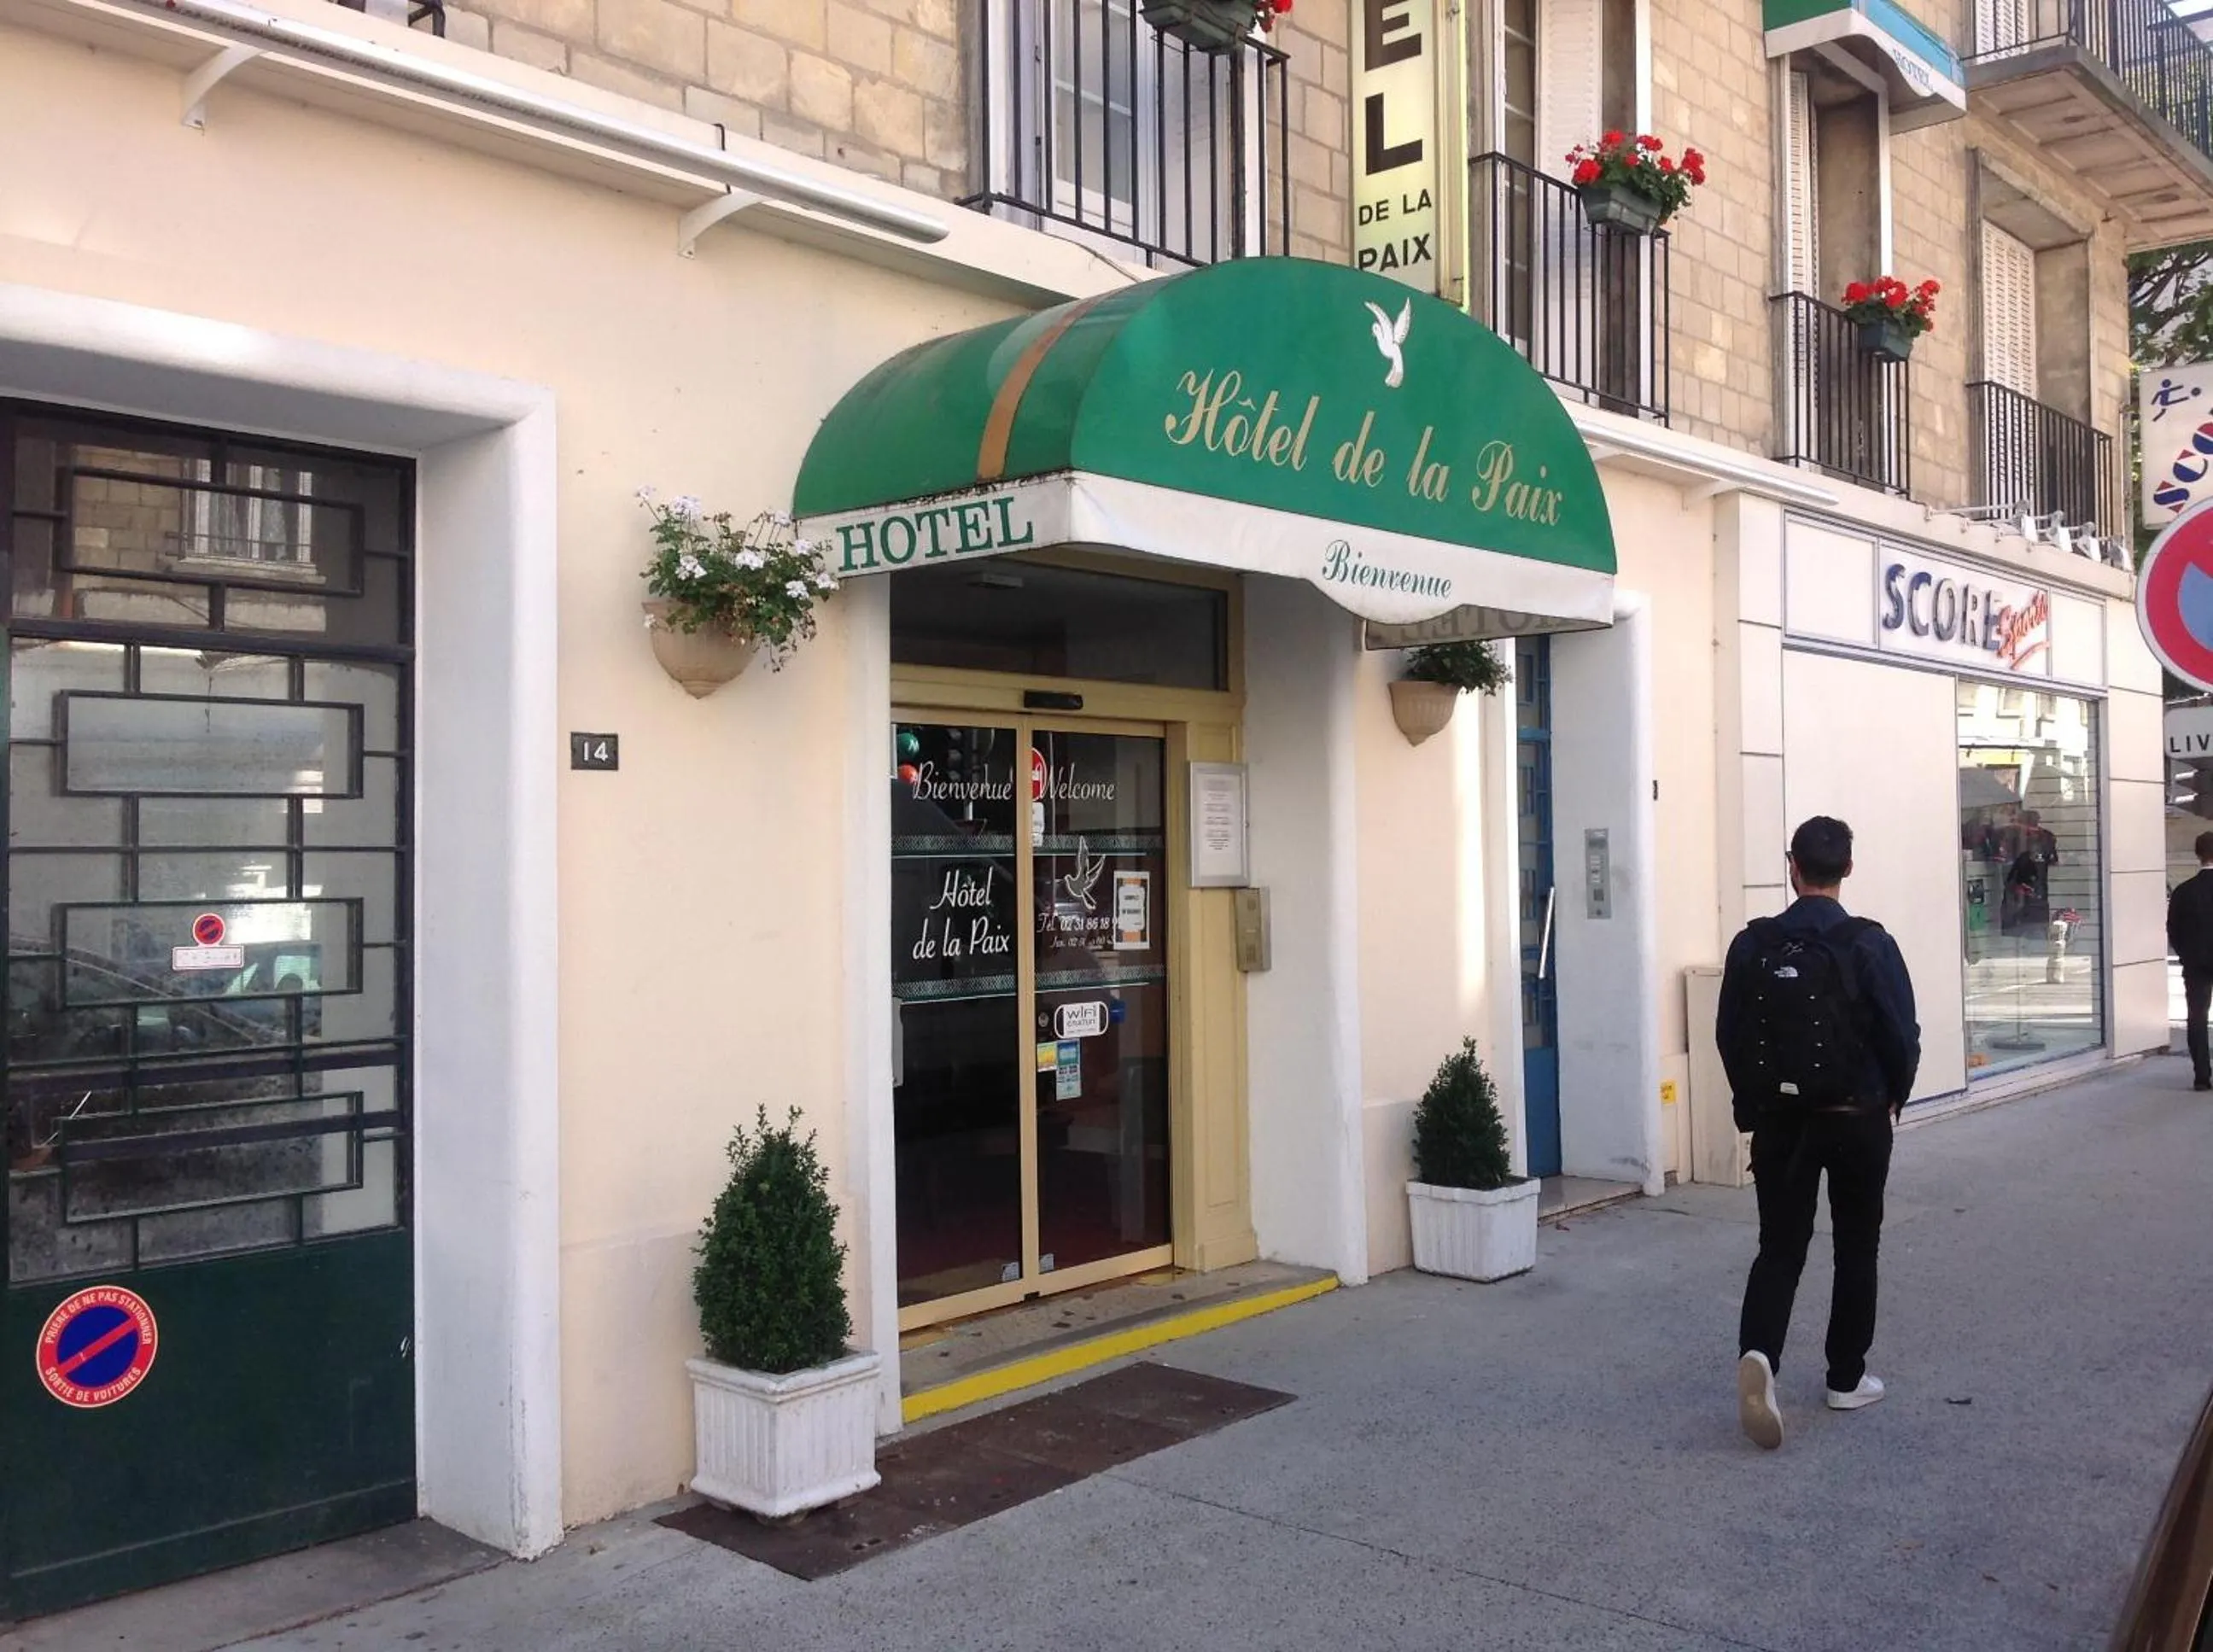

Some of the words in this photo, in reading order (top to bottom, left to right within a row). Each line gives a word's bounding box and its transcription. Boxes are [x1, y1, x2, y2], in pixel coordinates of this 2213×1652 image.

[1892, 47, 1934, 91] HOTEL
[1358, 199, 1389, 226] DE
[1403, 188, 1432, 214] LA
[1358, 233, 1432, 272] PAIX
[1165, 369, 1321, 471] Hôtel
[1334, 412, 1386, 487] de
[1408, 426, 1450, 503] la
[1472, 440, 1563, 527] Paix
[836, 496, 1033, 572] HOTEL
[1322, 540, 1451, 598] Bienvenue
[1882, 563, 2003, 651] SCORE
[584, 741, 608, 762] 14
[2170, 734, 2210, 752] LIV
[913, 761, 1013, 800] Bienvenue
[1036, 762, 1115, 800] Welcome
[929, 866, 994, 909] Hôtel
[912, 917, 936, 960] de
[943, 916, 961, 957] la
[969, 915, 1010, 955] Paix
[67, 1299, 81, 1314] DE
[81, 1292, 97, 1305] NE
[97, 1291, 120, 1303] PAS
[118, 1294, 152, 1345] STATIONNER
[45, 1366, 75, 1398] SORTIE
[76, 1390, 91, 1402] DE
[93, 1366, 142, 1402] VOITURES
